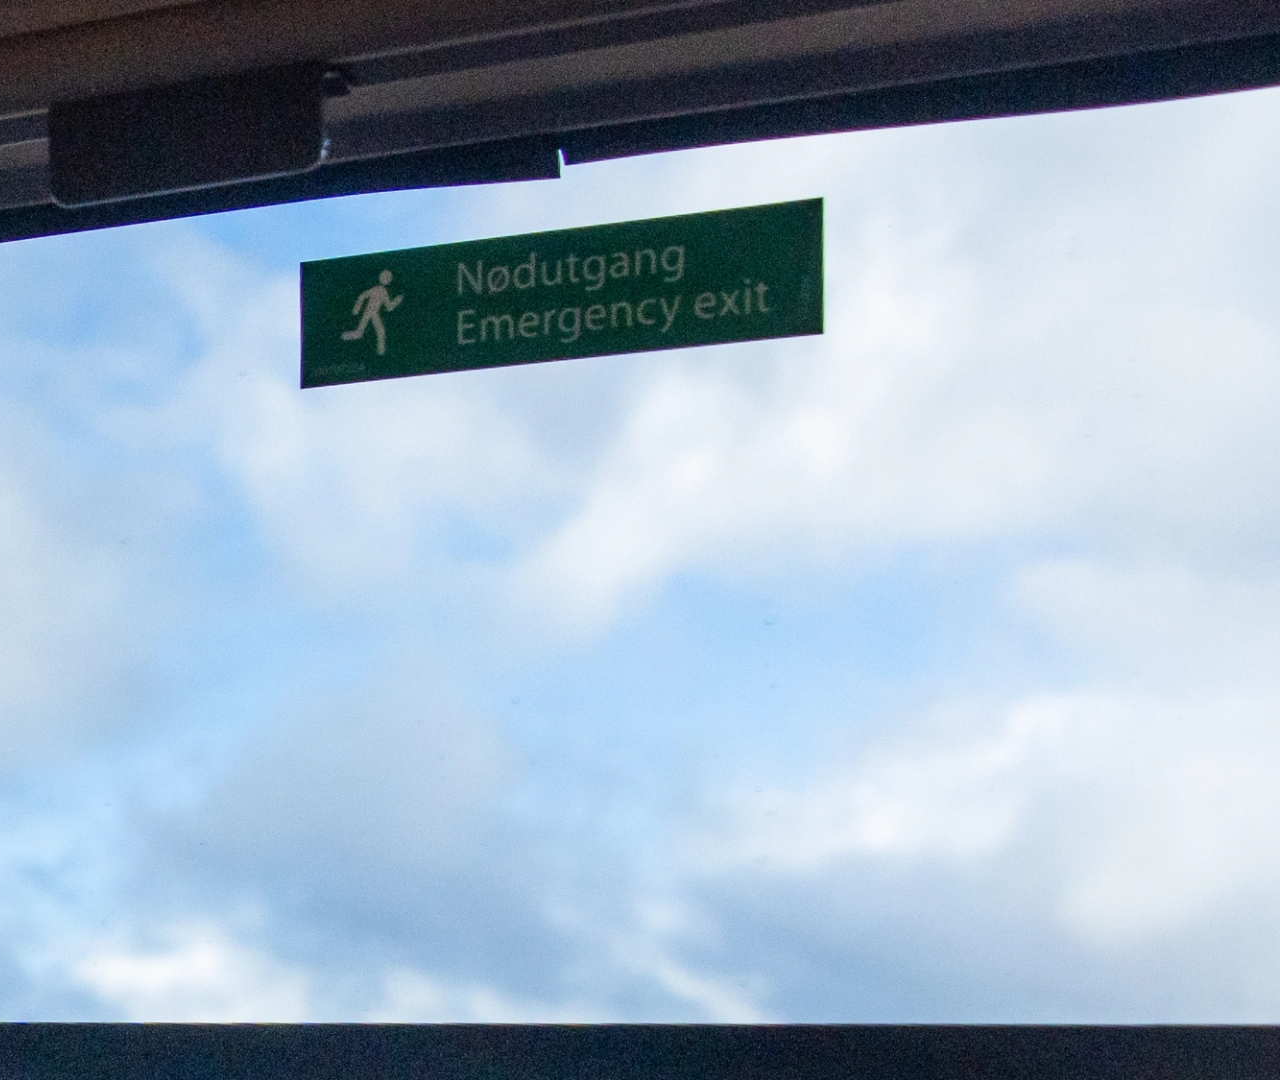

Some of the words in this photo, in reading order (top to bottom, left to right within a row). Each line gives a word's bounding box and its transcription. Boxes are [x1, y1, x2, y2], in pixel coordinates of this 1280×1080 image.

[456, 245, 686, 295] Nødutgang
[456, 295, 681, 346] Emergency
[693, 279, 770, 319] exit
